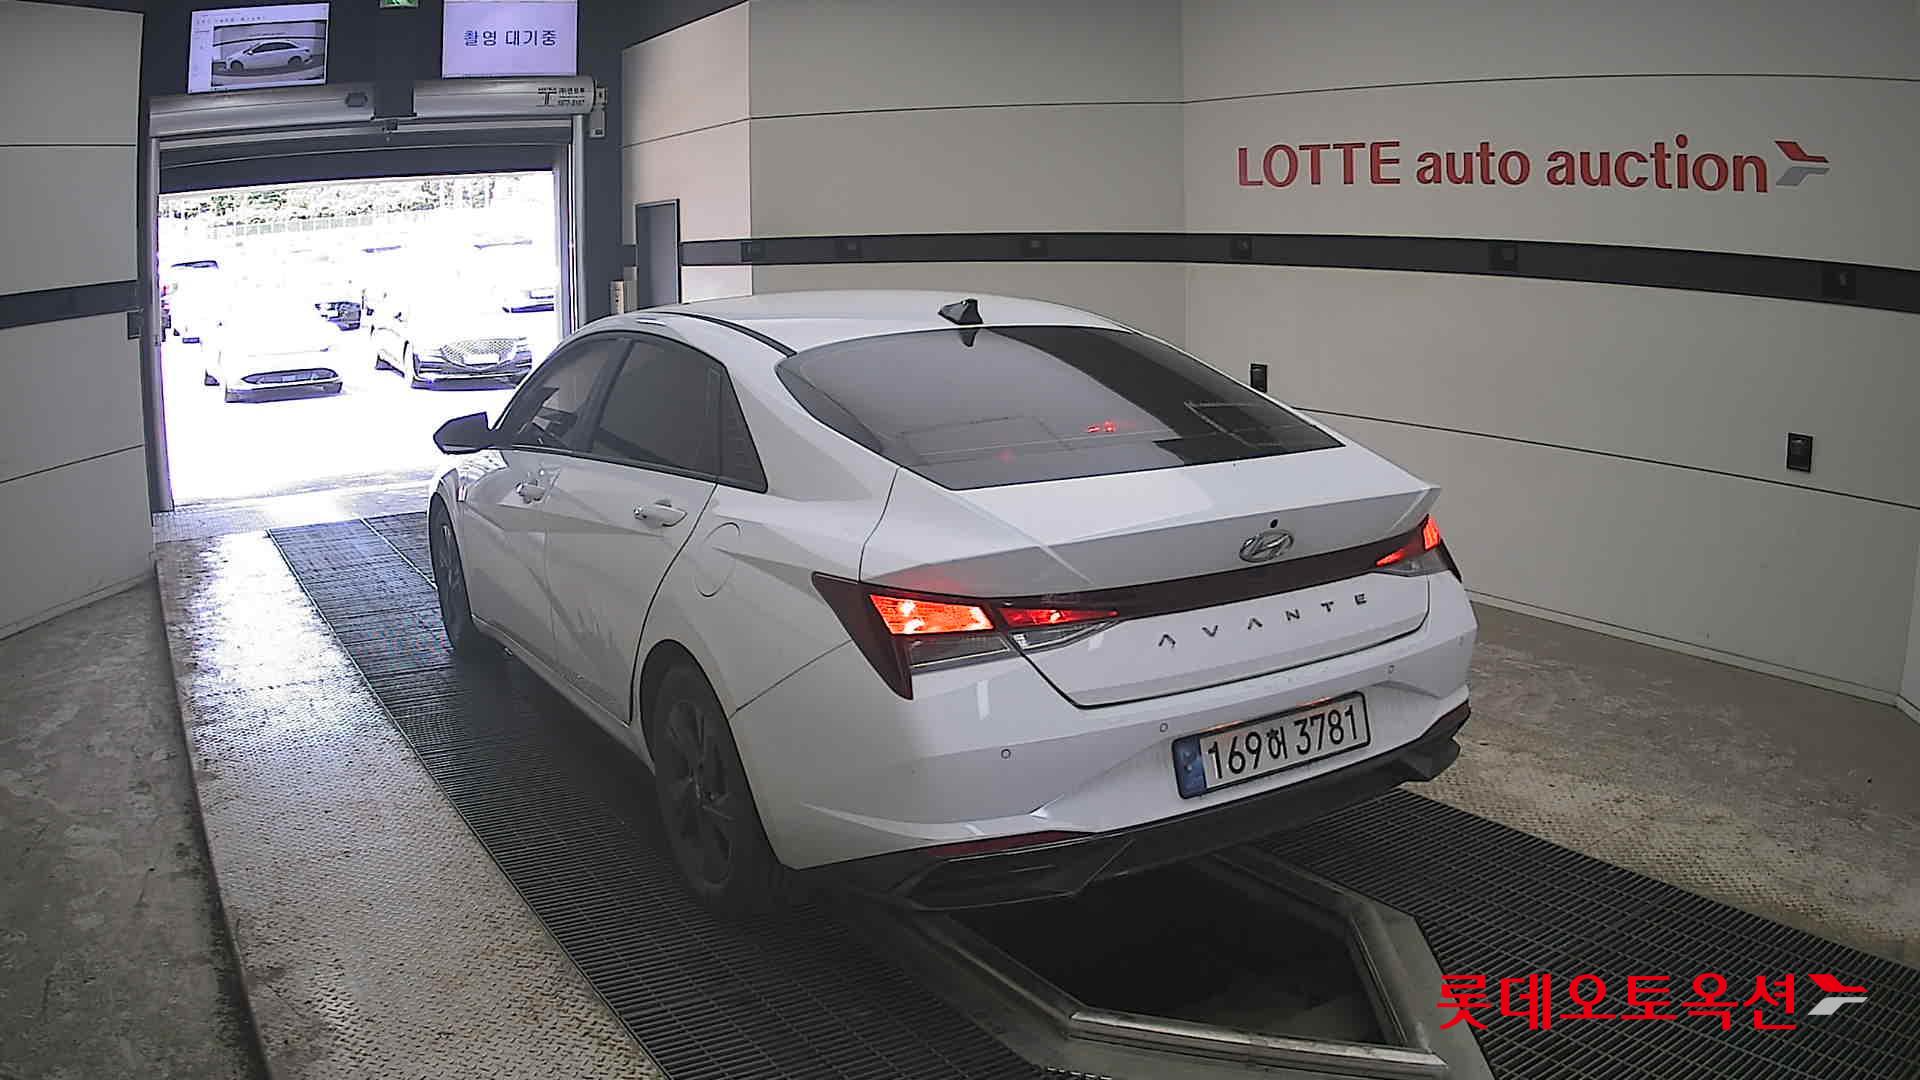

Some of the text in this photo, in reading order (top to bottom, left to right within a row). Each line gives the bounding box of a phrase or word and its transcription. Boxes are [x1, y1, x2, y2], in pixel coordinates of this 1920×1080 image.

[505, 30, 556, 46] 대기중
[1237, 134, 1769, 193] LOTTE auto auction
[1158, 593, 1368, 648] AVANTE
[1207, 704, 1358, 780] 169허 3781
